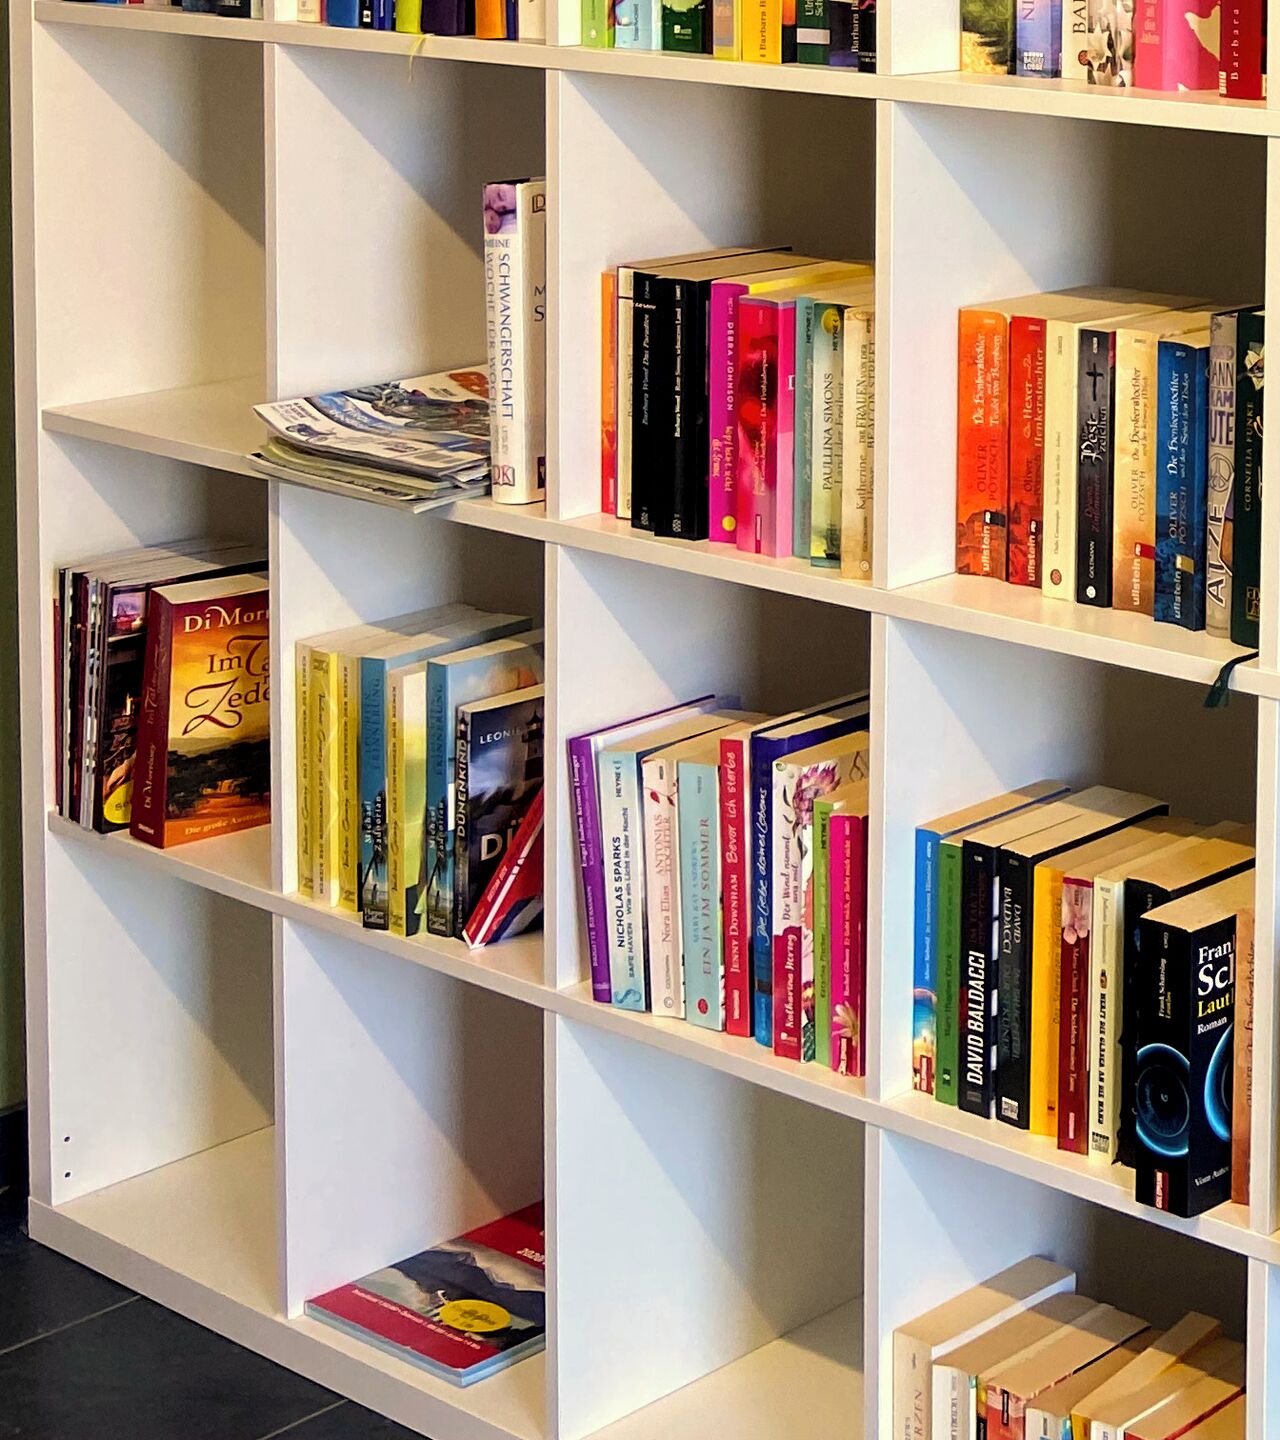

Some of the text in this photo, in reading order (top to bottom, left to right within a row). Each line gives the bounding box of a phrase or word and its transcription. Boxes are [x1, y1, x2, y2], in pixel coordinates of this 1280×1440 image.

[497, 252, 514, 421] SCHWANGERSCHAFT
[823, 372, 834, 491] PAULLINA SIMONS
[1244, 401, 1254, 512] CORNELIA FUNKE
[982, 525, 991, 571] ullstein
[456, 739, 467, 838] DÜNENKIND
[611, 836, 626, 948] NICHOLAS SPARKS
[728, 872, 741, 974] JENNY DOWNHAM
[966, 950, 986, 1085] DAVID BALDACCI
